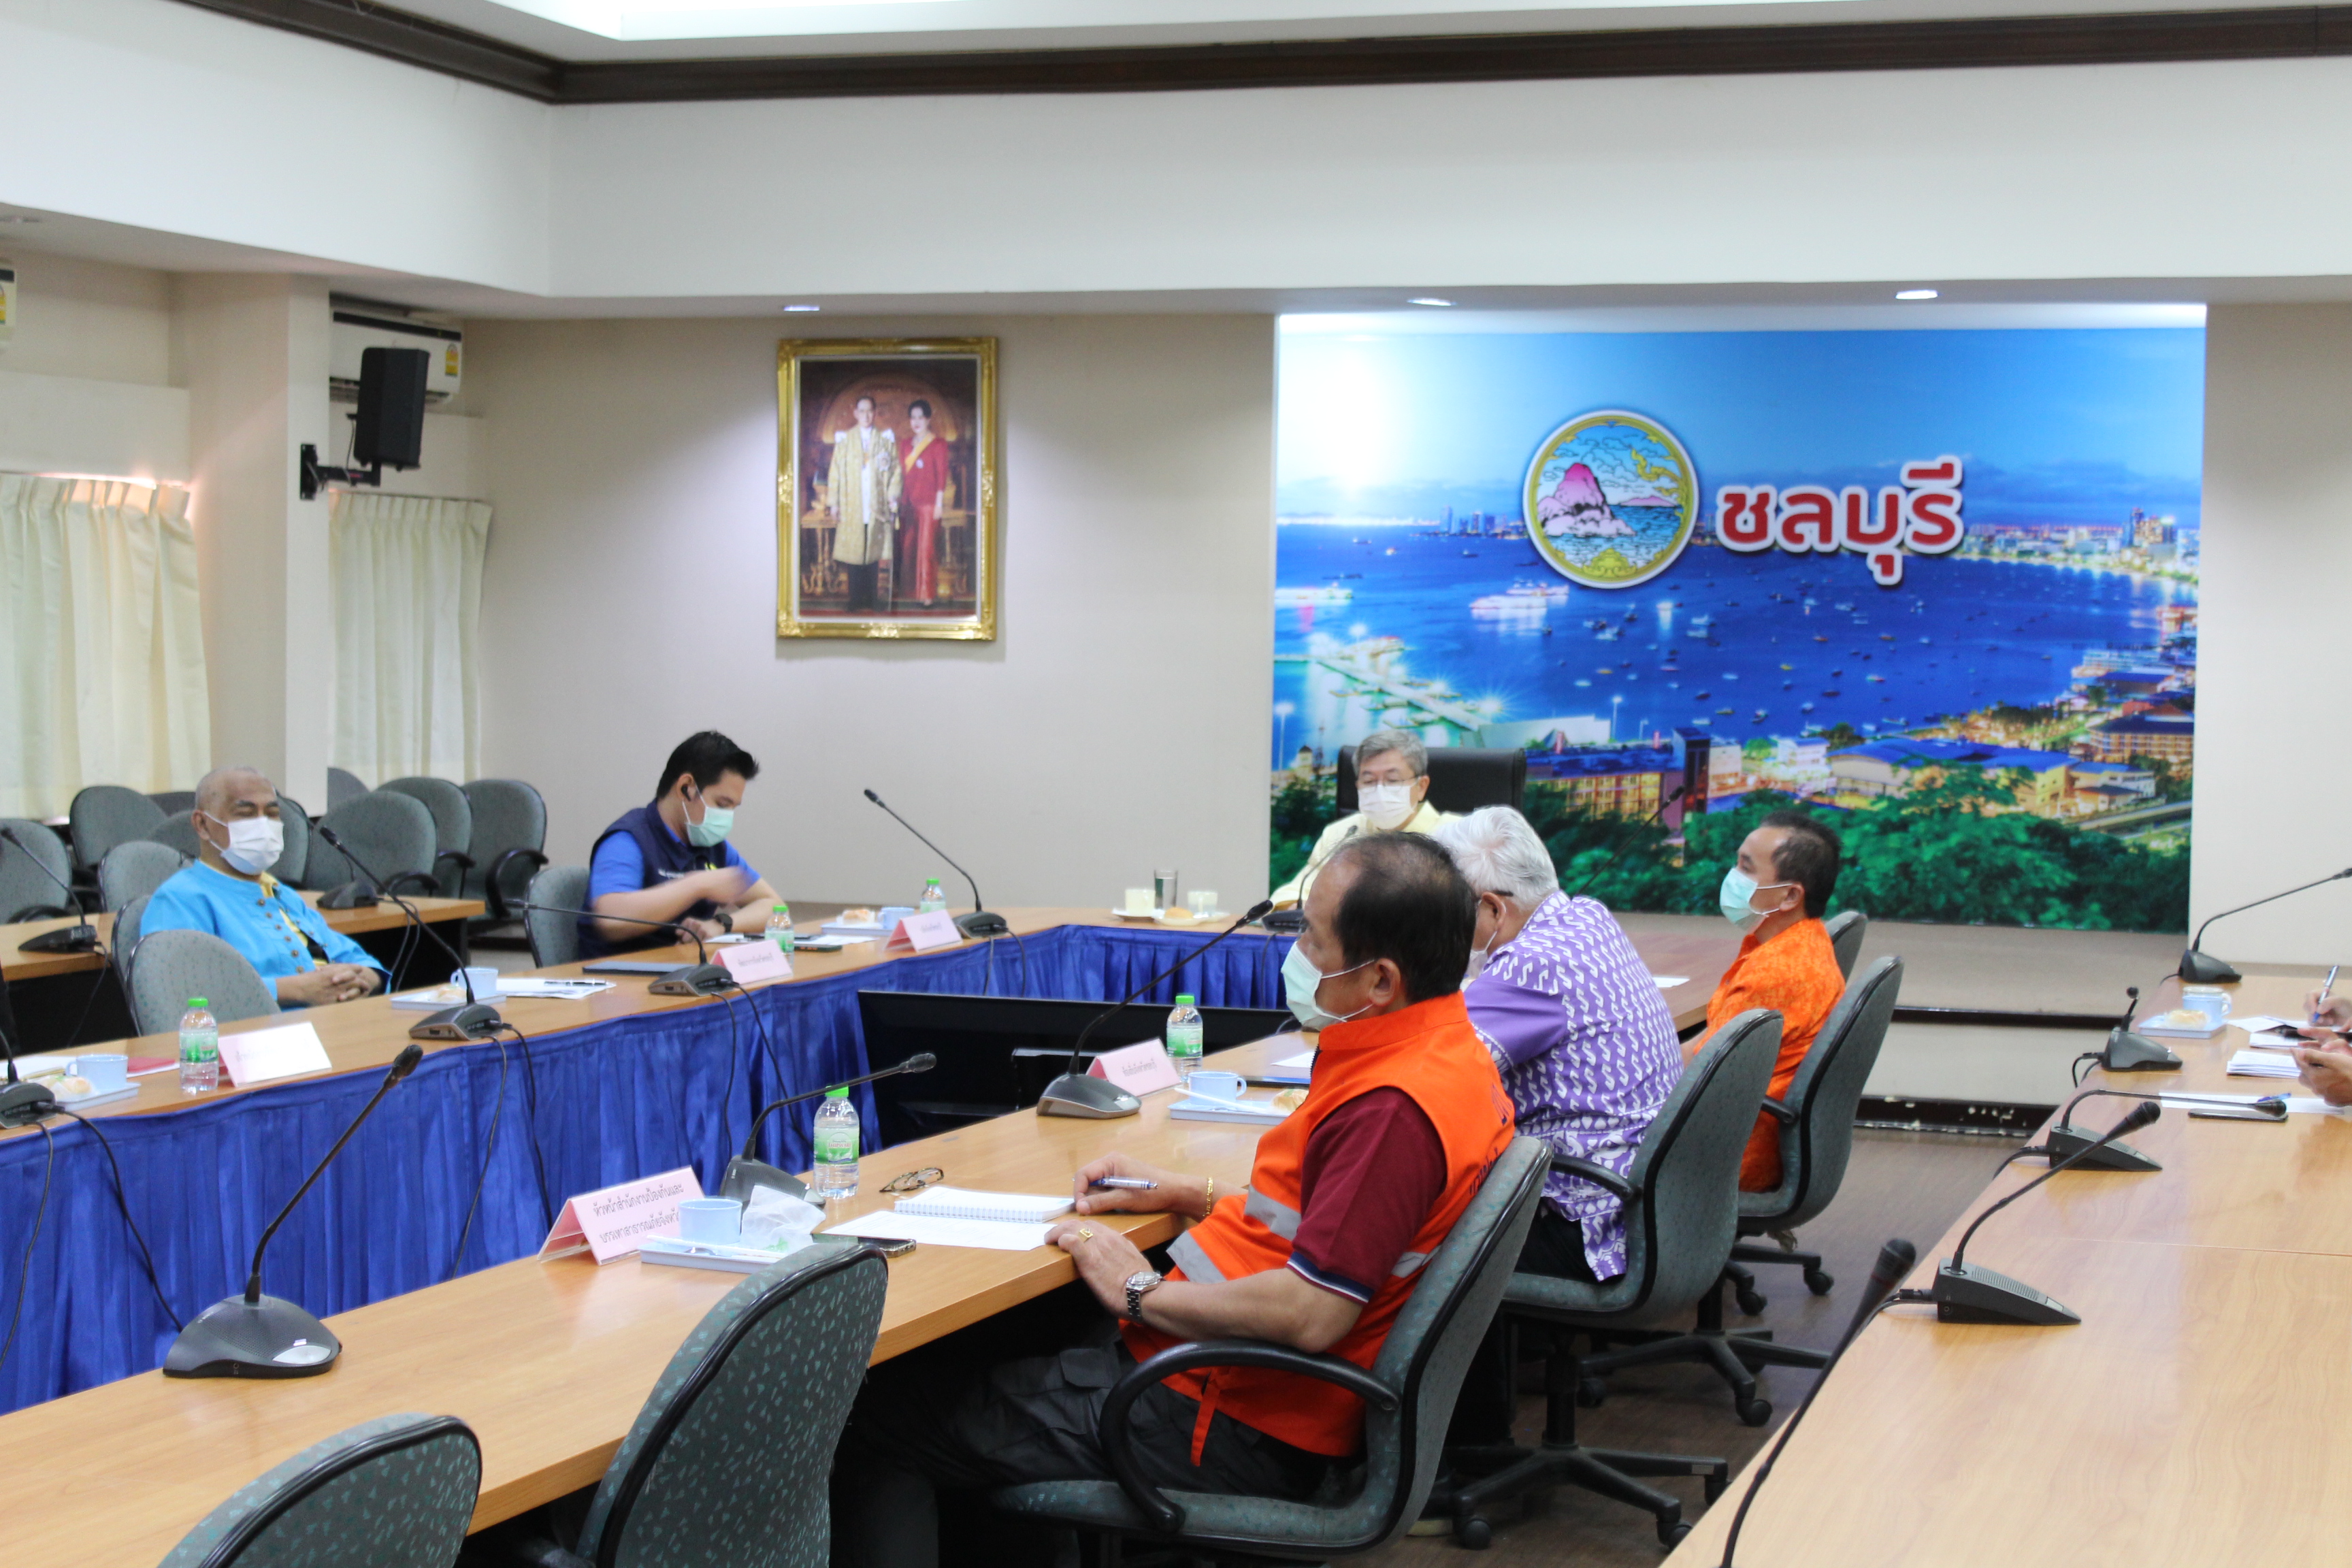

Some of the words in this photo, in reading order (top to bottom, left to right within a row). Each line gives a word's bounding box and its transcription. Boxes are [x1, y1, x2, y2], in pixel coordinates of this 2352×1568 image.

[1717, 455, 1964, 585] ชลบุรี
[599, 1208, 679, 1243] บรรเทาสาธารณภัยจังหวั
